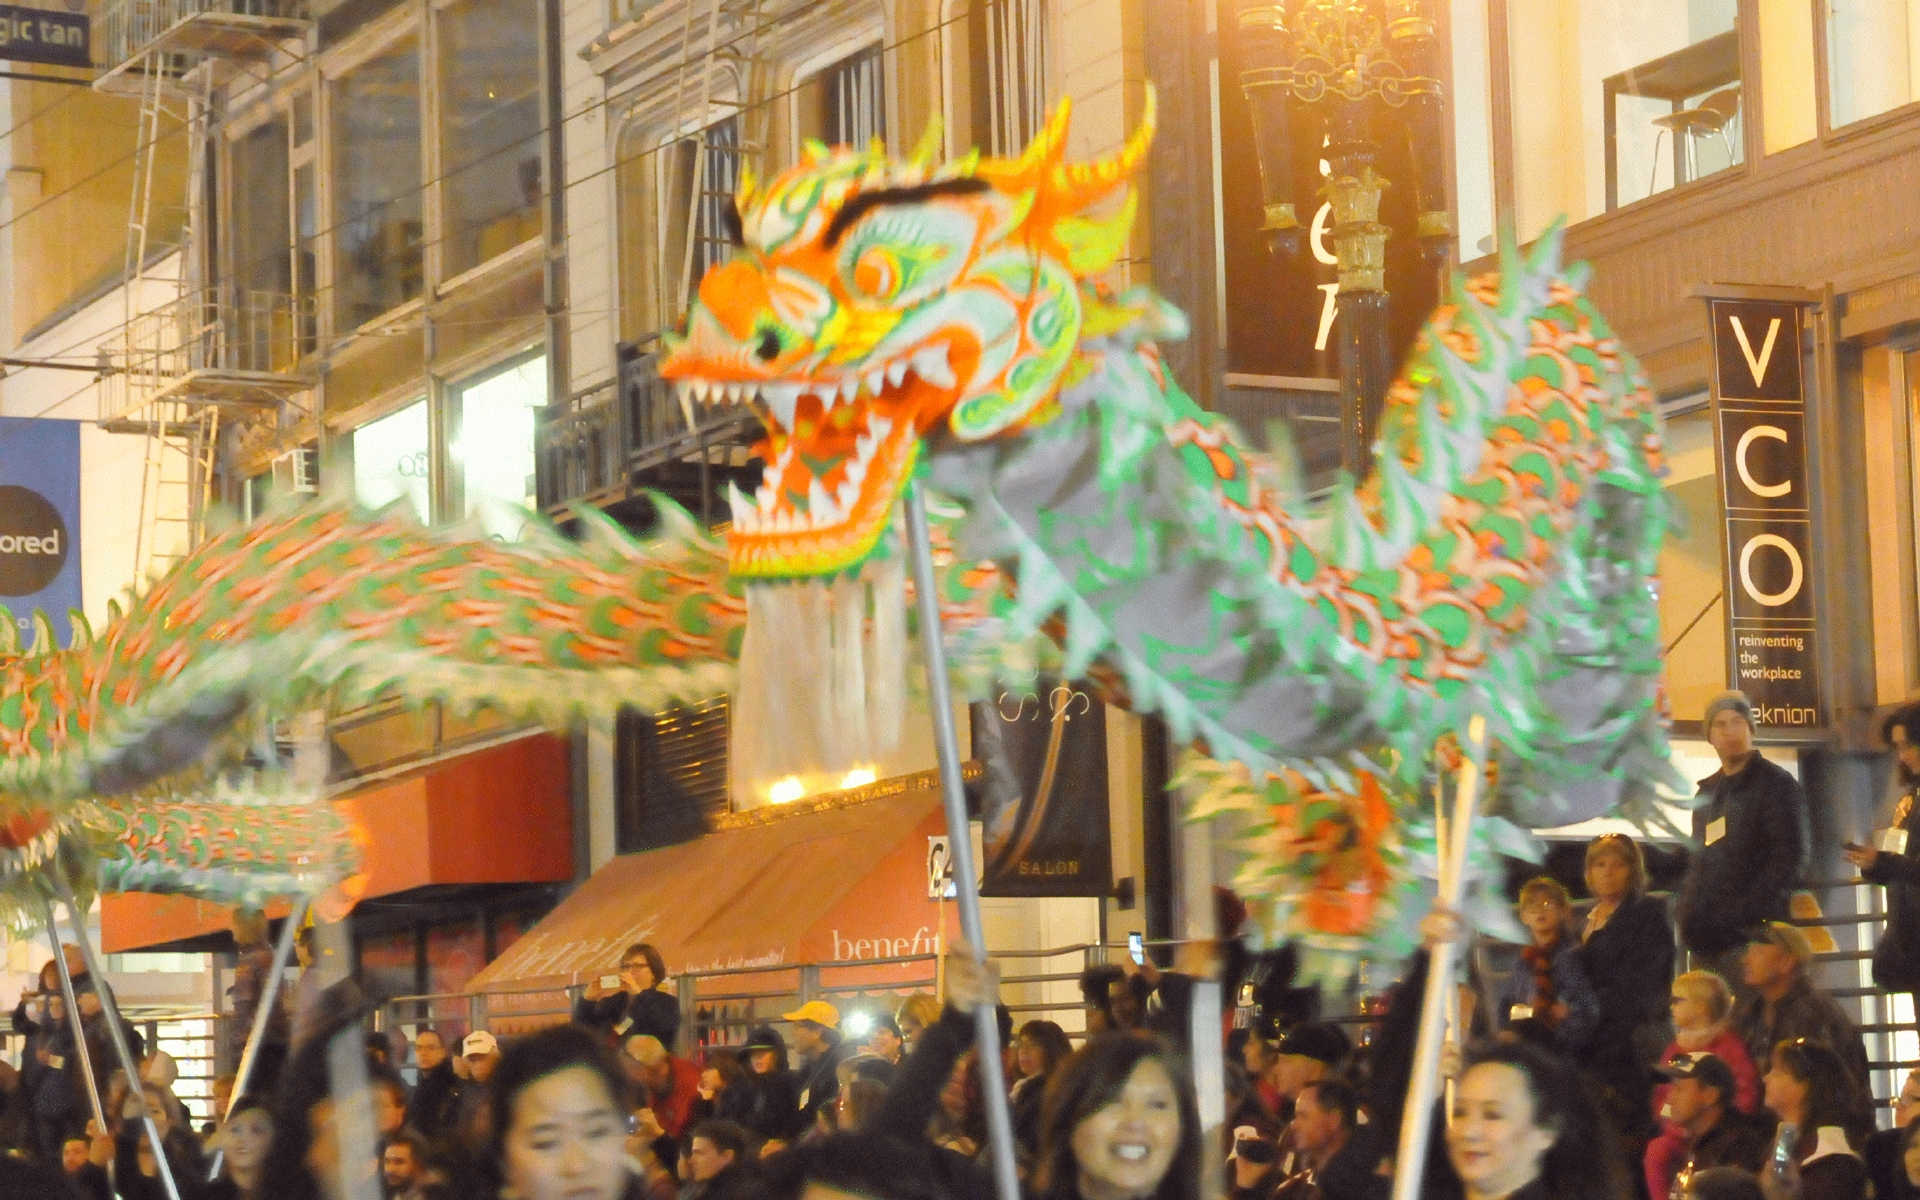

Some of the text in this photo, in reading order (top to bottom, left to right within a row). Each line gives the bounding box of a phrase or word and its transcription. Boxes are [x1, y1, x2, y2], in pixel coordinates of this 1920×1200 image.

[40, 21, 84, 47] tan
[1729, 315, 1804, 607] VCO
[0, 528, 60, 555] ored
[1739, 634, 1804, 652] reinventing
[1740, 651, 1759, 664] the
[1741, 666, 1802, 682] workplace
[1018, 861, 1080, 875] SALON
[831, 926, 940, 967] benefit
